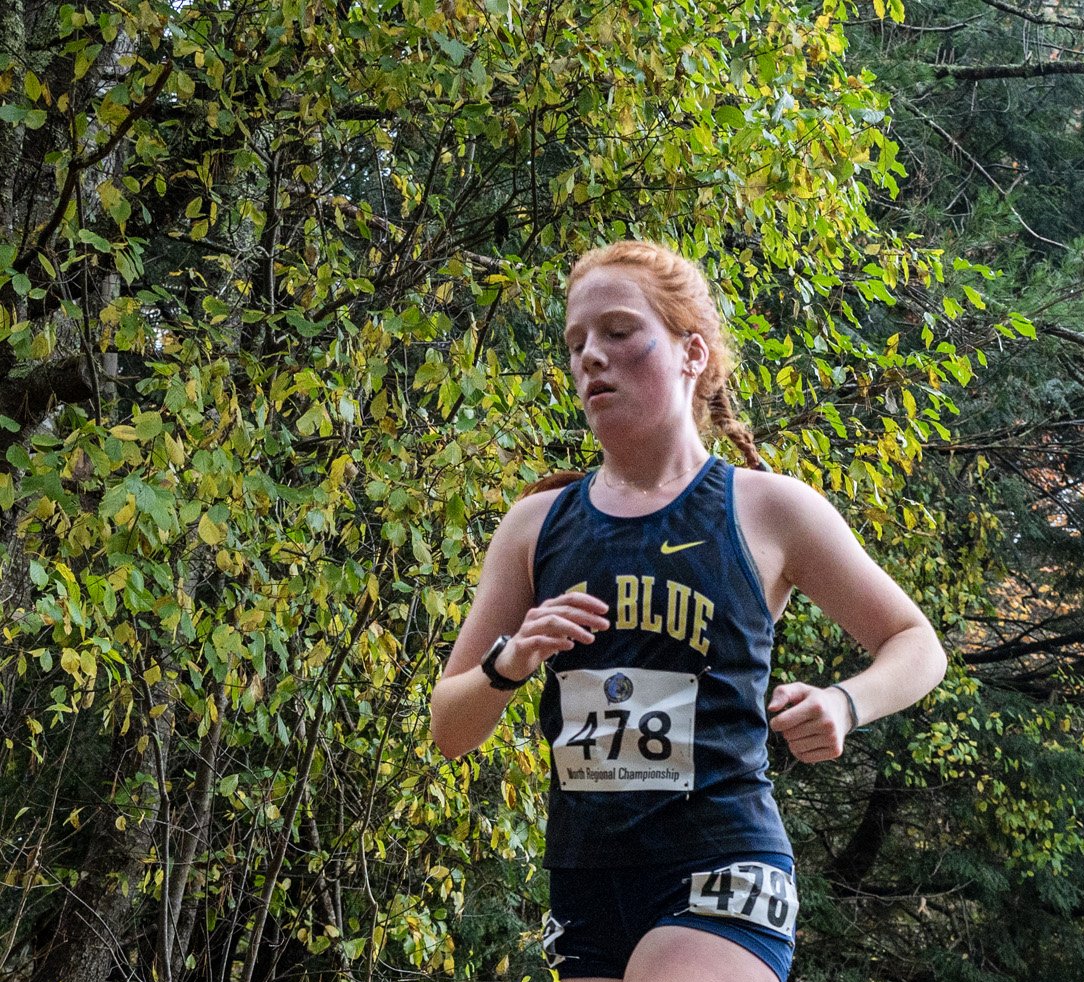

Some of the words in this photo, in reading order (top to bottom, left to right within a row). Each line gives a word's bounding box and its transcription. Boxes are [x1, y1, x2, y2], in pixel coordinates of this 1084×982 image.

[615, 574, 715, 657] BLUE
[566, 709, 672, 761] 478
[586, 767, 616, 782] Regional
[618, 767, 680, 782] Championship
[701, 864, 789, 928] 478
